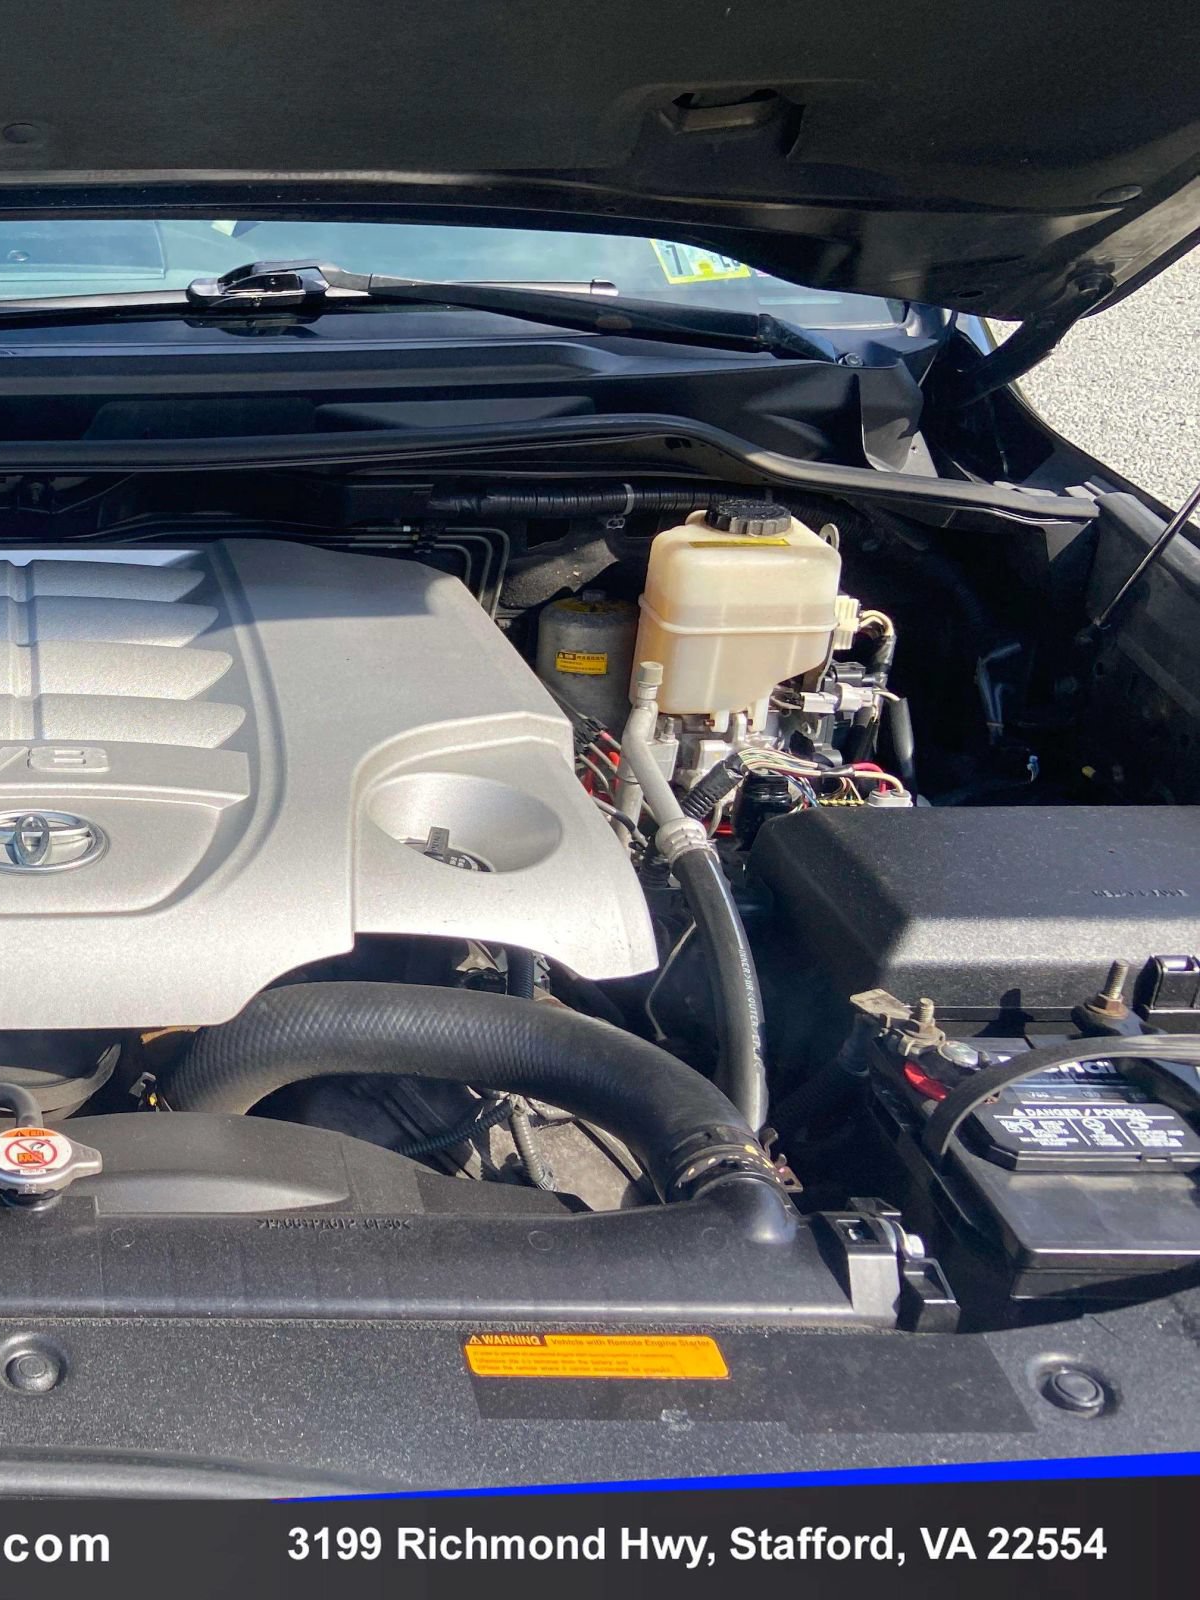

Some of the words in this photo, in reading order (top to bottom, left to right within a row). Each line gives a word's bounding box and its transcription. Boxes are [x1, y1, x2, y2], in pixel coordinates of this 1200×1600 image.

[1024, 1108, 1083, 1117] DANGER
[1092, 1108, 1146, 1117] POISON
[481, 1335, 541, 1345] WARNING
[645, 1339, 676, 1348] Engine
